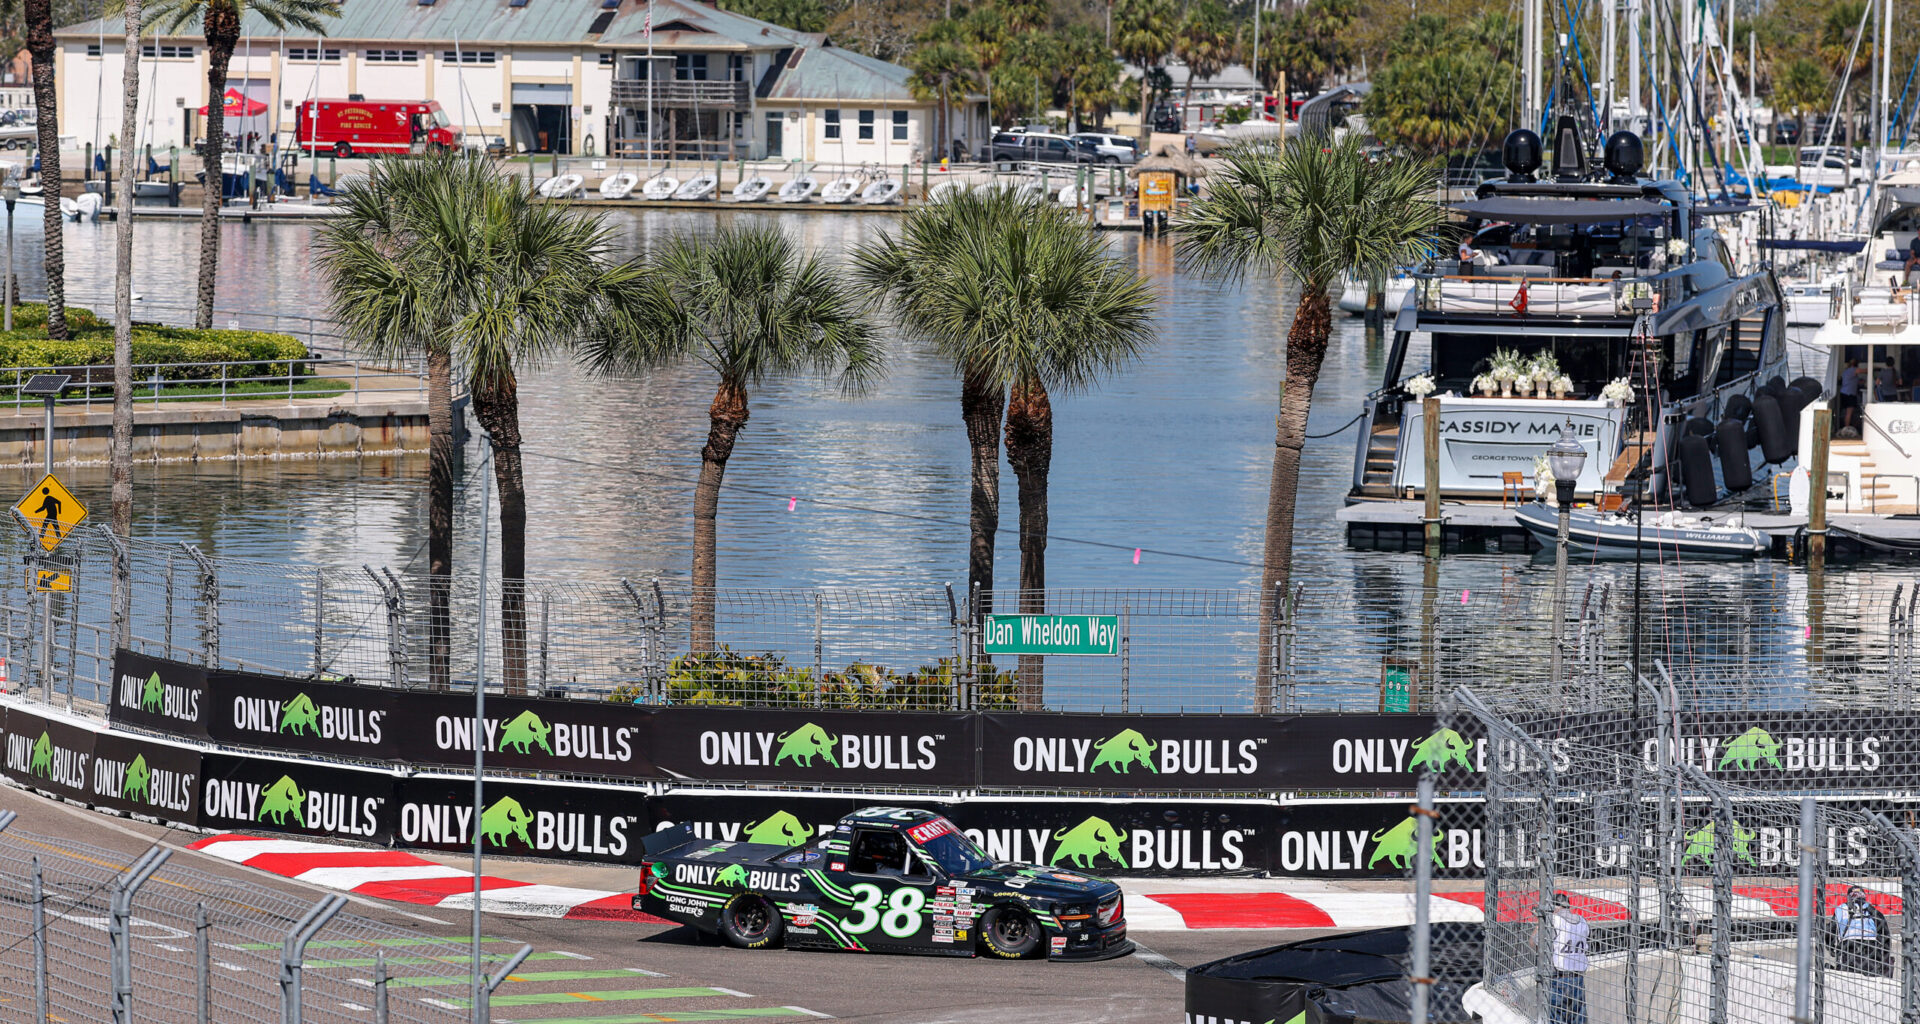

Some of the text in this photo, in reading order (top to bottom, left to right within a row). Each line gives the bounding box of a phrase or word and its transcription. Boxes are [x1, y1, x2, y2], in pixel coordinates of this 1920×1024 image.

[1528, 422, 1594, 436] MAIE
[1685, 532, 1732, 541] WILLIAMS
[987, 616, 1116, 653] Dan Wheldon Way
[119, 674, 144, 711] ONLY
[234, 695, 280, 733] ONLY
[7, 732, 34, 774] ONLY
[700, 730, 775, 766] ONLY
[1013, 736, 1091, 773] ONLY
[1332, 738, 1409, 774] ONLY
[94, 757, 126, 799] ONLY
[205, 778, 260, 822] ONLY
[401, 802, 473, 844] ONLY
[1281, 830, 1369, 872] ONLY
[675, 863, 717, 886] ONLY
[665, 895, 708, 908] LONG JOHN
[669, 903, 704, 917] SILVER'S
[840, 883, 925, 938] 38
[1080, 933, 1089, 941] 38
